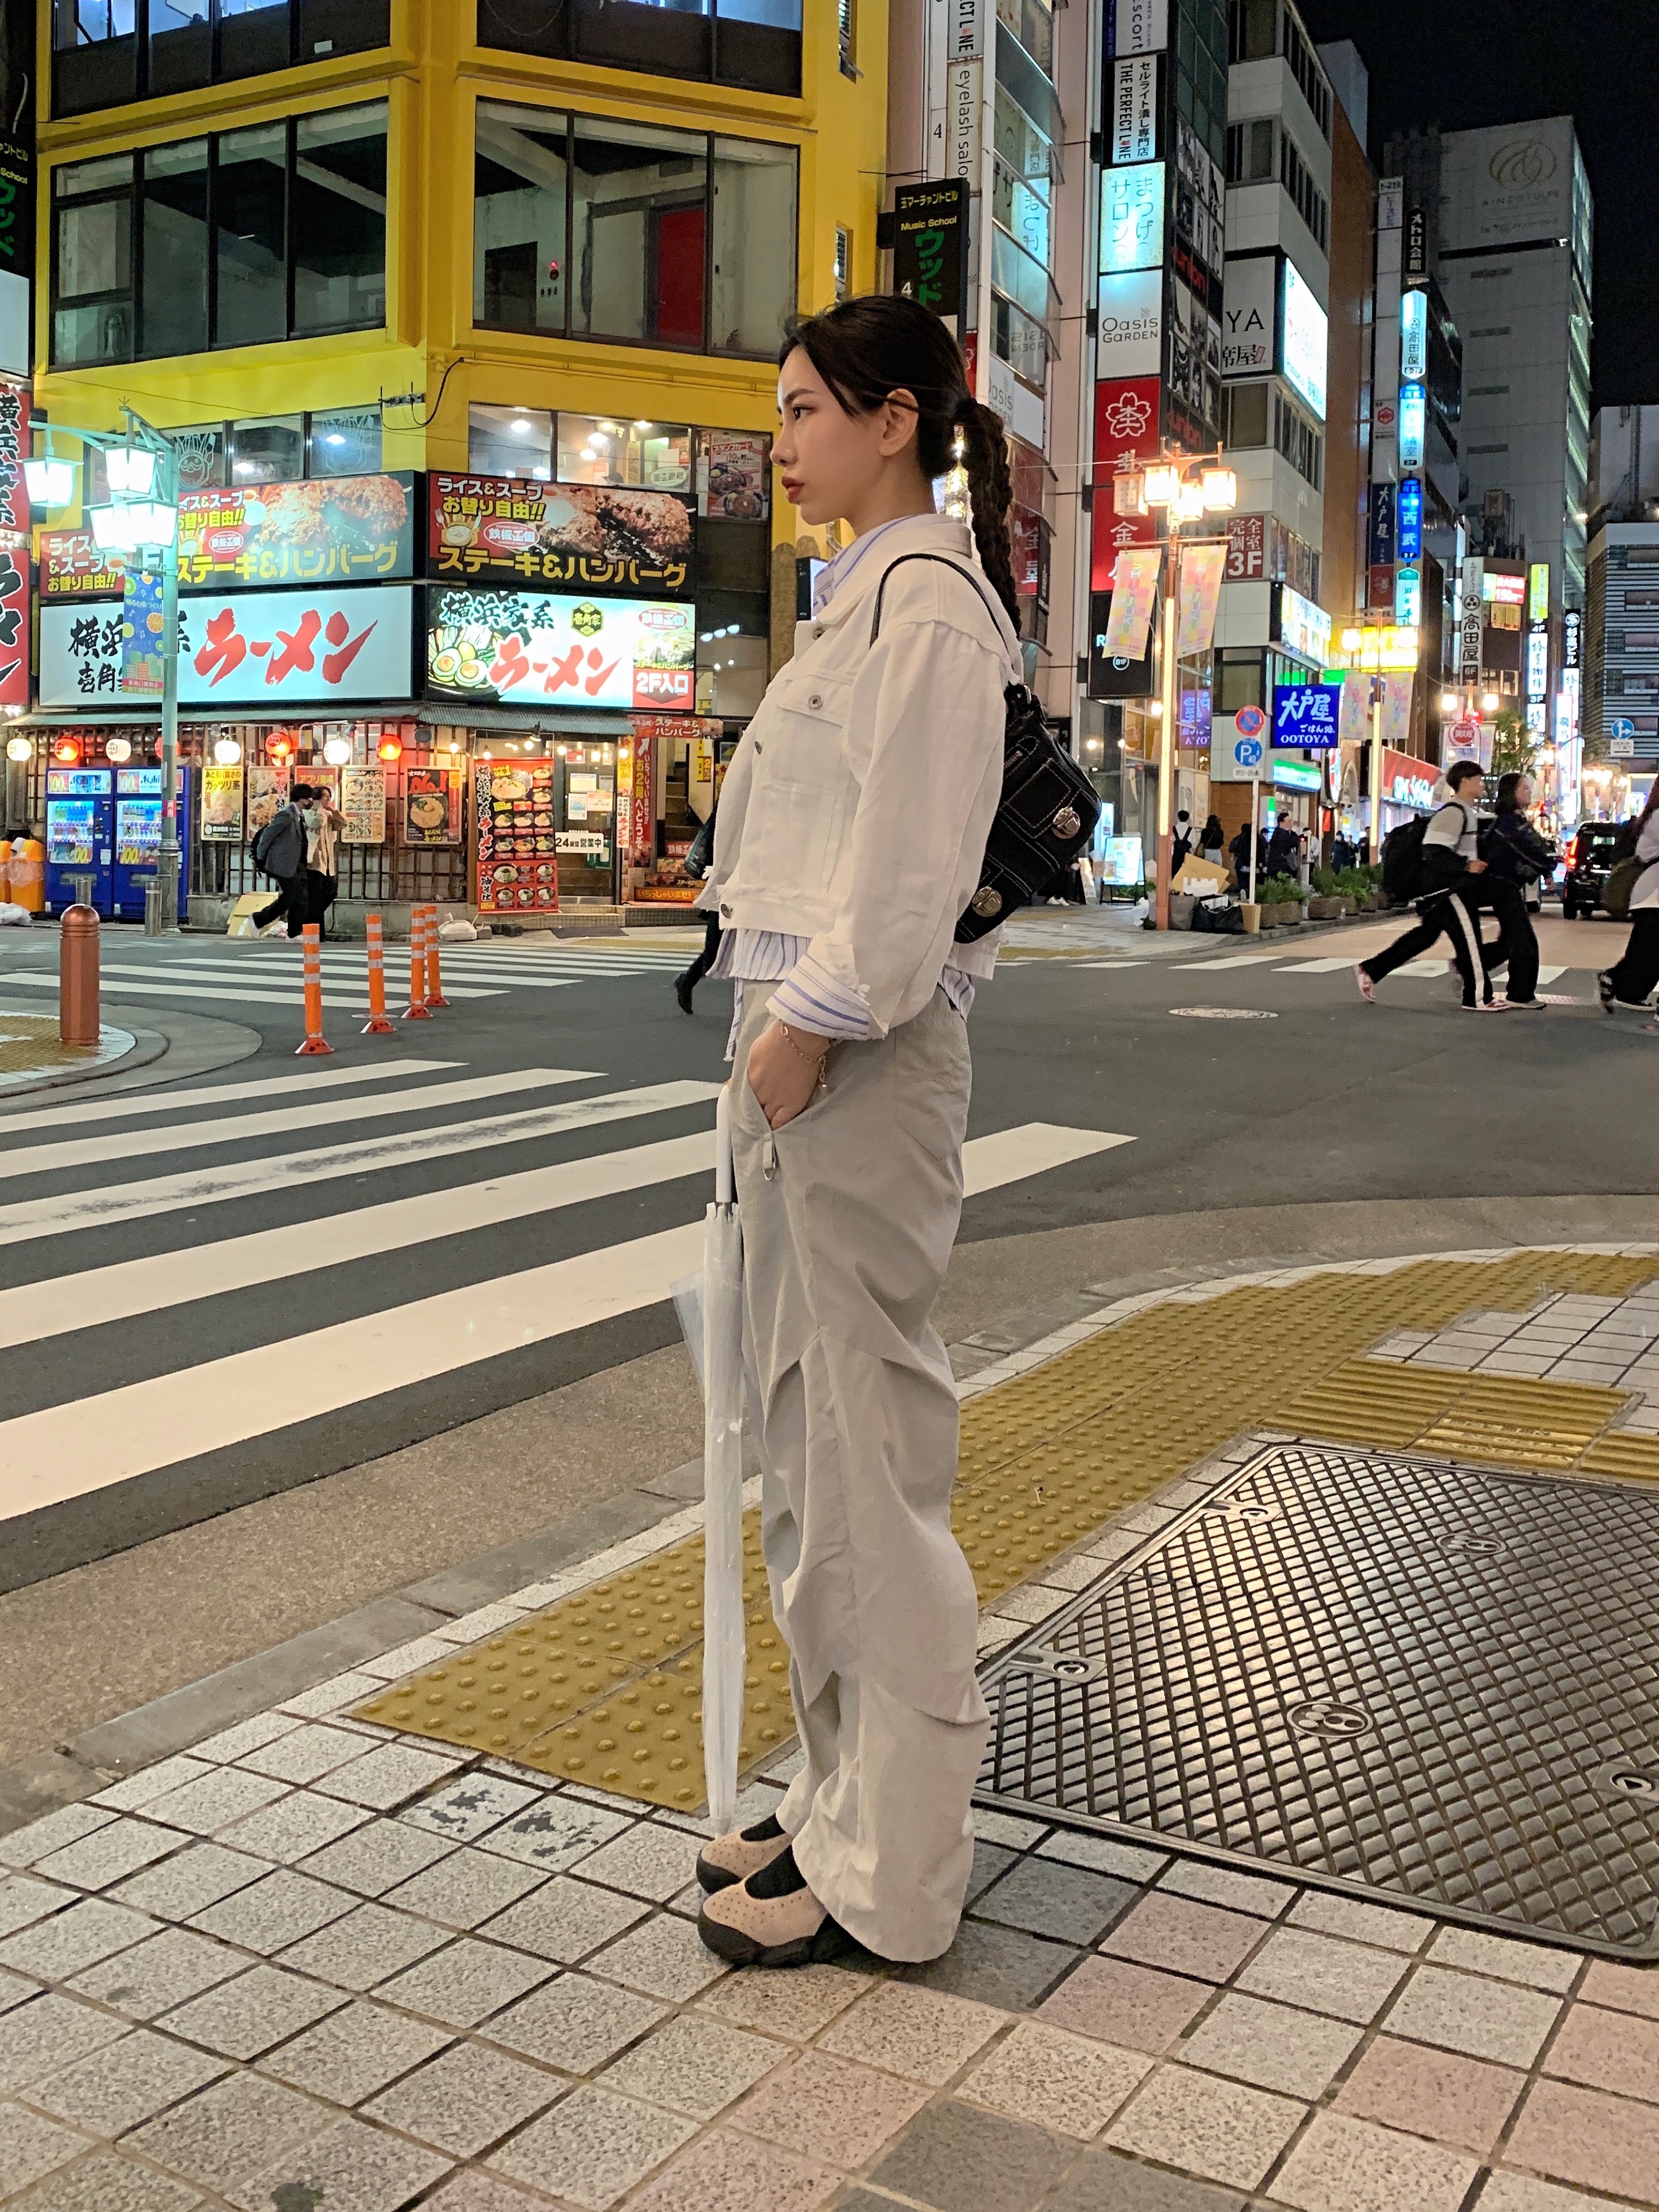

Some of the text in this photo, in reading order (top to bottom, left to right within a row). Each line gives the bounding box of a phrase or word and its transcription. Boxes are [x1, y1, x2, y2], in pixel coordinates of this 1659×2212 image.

[1132, 0, 1143, 50] scort
[1120, 63, 1133, 84] THE
[1119, 86, 1133, 132] PERFECT
[1138, 62, 1151, 158] セルライト潰し専門店
[933, 123, 942, 138] 4
[955, 69, 974, 179] eyelash salo
[0, 167, 28, 185] School
[1111, 179, 1131, 242] サロン
[1135, 177, 1154, 241] まつげ
[901, 216, 957, 231] Music School
[914, 228, 945, 307] ウッド
[901, 281, 912, 296] 4
[1225, 308, 1265, 333] YA
[438, 478, 543, 501] ライス&スープ
[443, 495, 546, 521] お替り自由!!
[489, 527, 535, 543] 鉄板王国
[1402, 511, 1418, 547] 西武
[49, 552, 105, 575] &スープ
[178, 540, 398, 584] ステーキ&ハンバーグ
[438, 546, 687, 587] ステーキ&ハンバーグ
[1227, 551, 1262, 577] 3F
[47, 571, 118, 593] お替り自由!!
[441, 593, 555, 630] 横浜家系
[1462, 613, 1480, 662] 高田屋
[1532, 625, 1545, 633] 4F
[193, 606, 378, 687] ラーメン
[78, 660, 123, 694] 壱角
[489, 636, 623, 696] ラーメン
[636, 671, 689, 694] 2F入口
[1277, 688, 1334, 727] 大戸屋
[1530, 695, 1543, 703] 3F
[655, 718, 700, 728] ステーキ&
[655, 727, 701, 737] ハンバーグ
[1281, 734, 1329, 743] OOTOYA
[1240, 745, 1252, 763] P
[140, 774, 160, 785] Asahi
[478, 816, 494, 861] ラーメン
[555, 837, 602, 849] 24時間営業中
